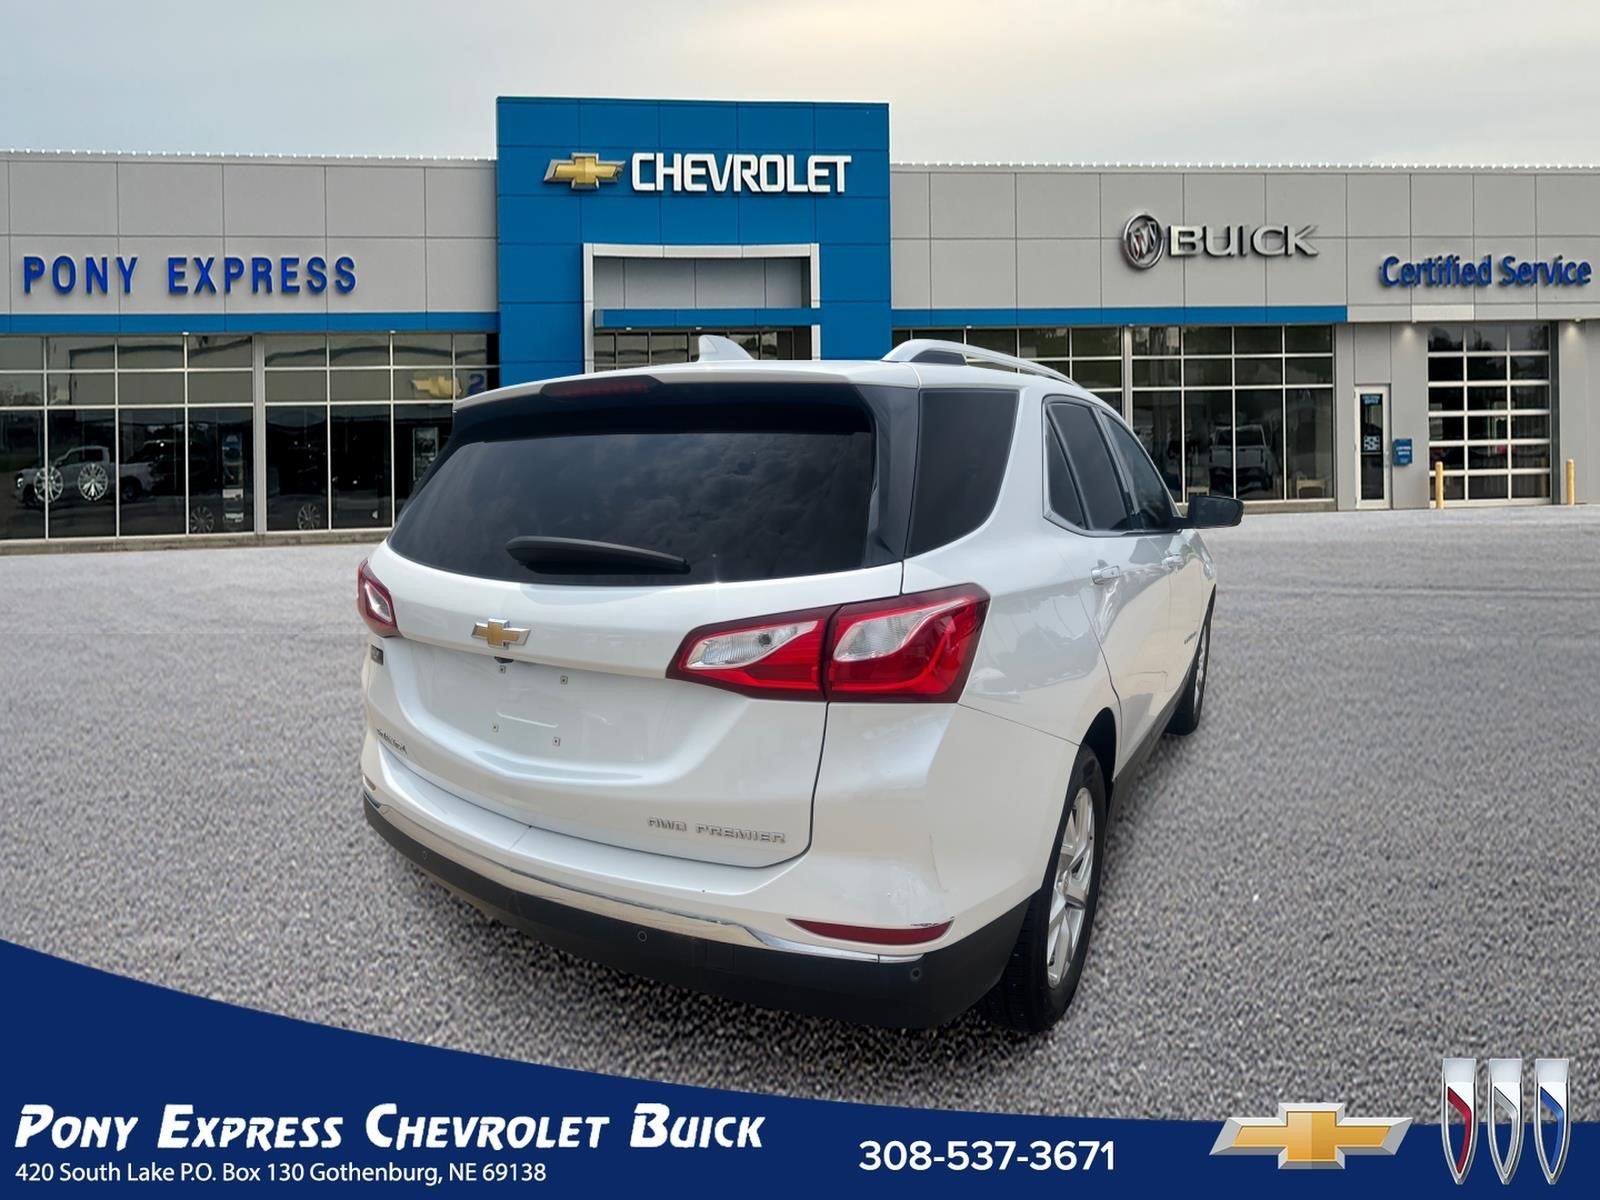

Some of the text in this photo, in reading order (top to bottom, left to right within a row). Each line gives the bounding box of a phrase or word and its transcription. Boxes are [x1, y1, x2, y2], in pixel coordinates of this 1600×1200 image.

[631, 152, 852, 194] CHEVROLET
[1169, 224, 1319, 257] BUICK
[23, 256, 357, 295] PONY EXPRESS
[1380, 254, 1592, 287] Certified Service
[647, 816, 787, 844] AWD PREMIER
